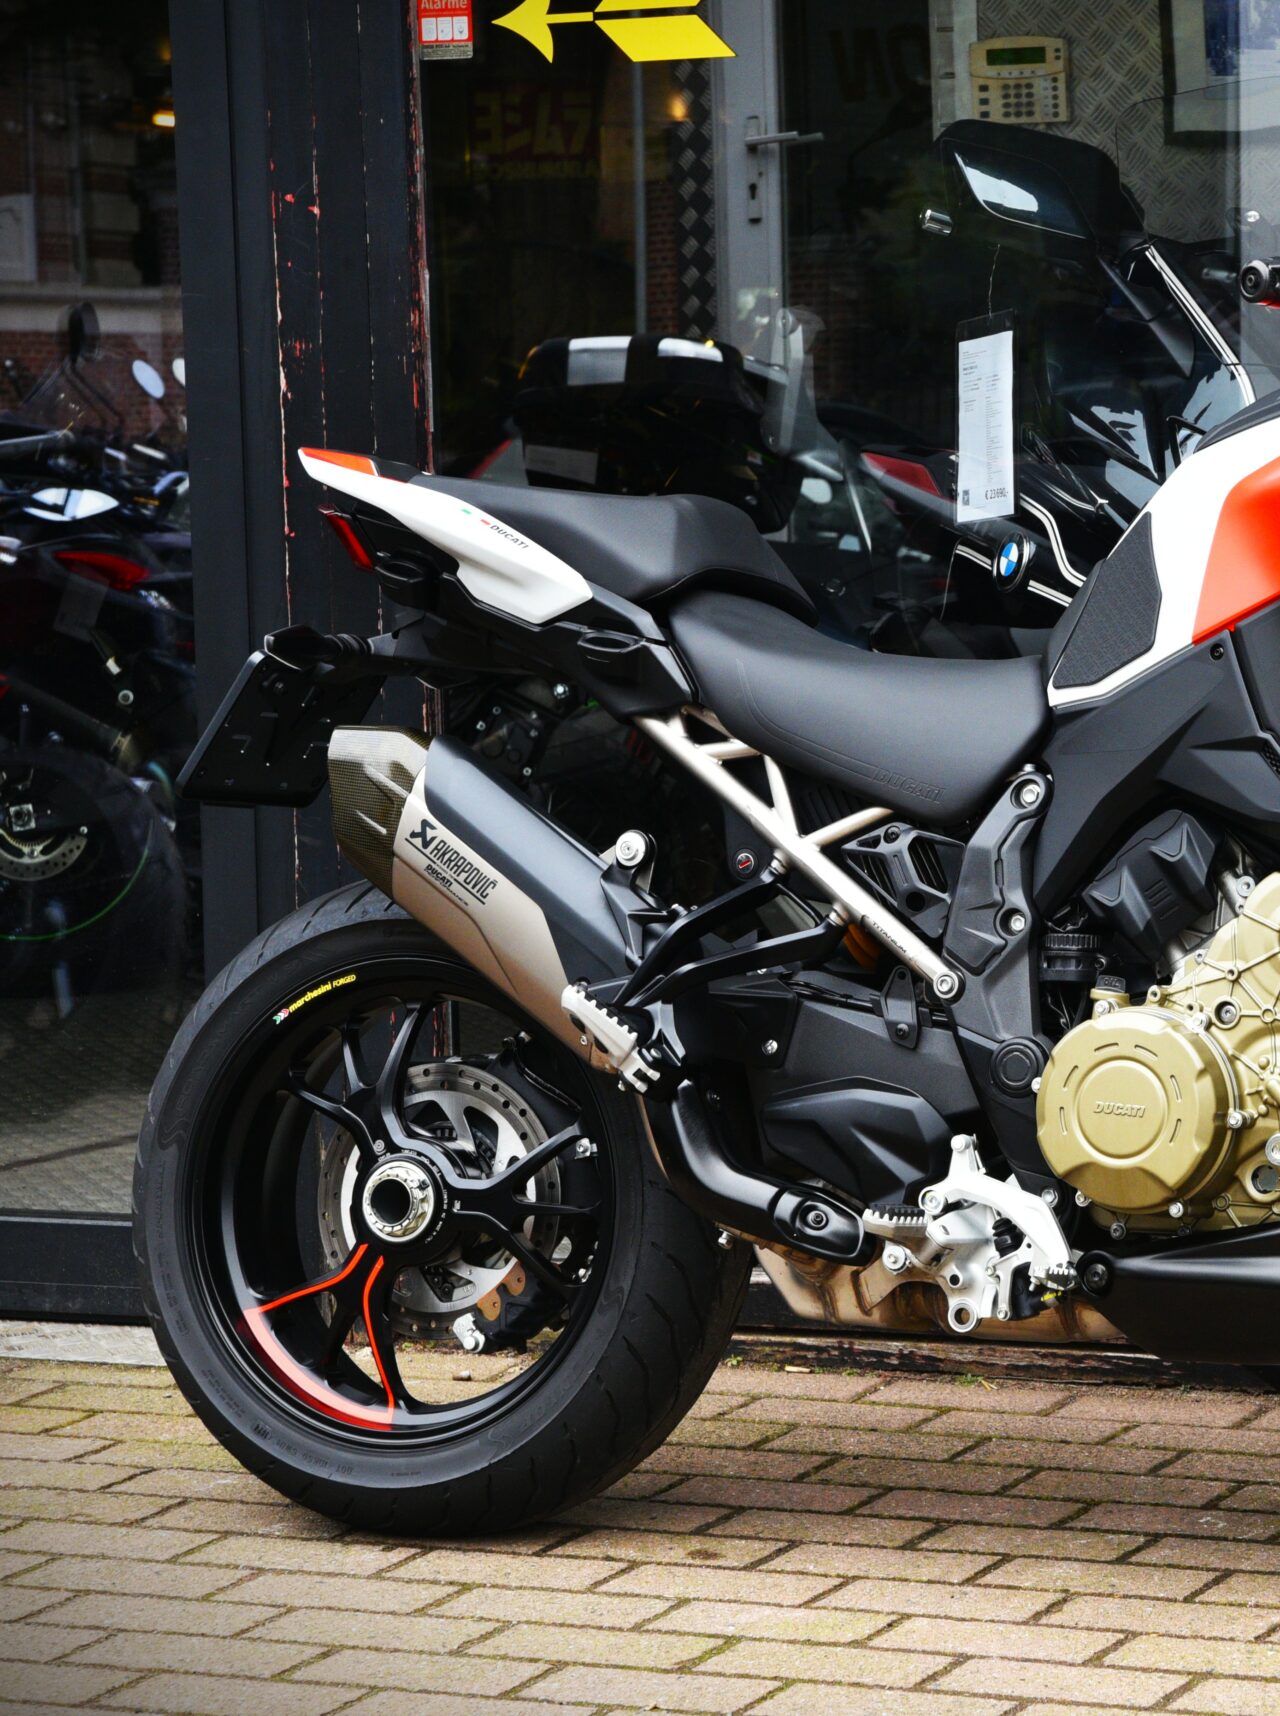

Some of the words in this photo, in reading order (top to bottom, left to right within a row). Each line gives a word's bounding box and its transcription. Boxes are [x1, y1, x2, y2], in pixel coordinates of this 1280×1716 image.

[490, 525, 529, 549] DUCATI
[873, 769, 945, 804] DUCATI
[426, 864, 453, 887] DUCATI
[288, 982, 332, 1013] marchesini
[332, 974, 357, 989] FORGED
[1093, 1100, 1146, 1118] DUCATI
